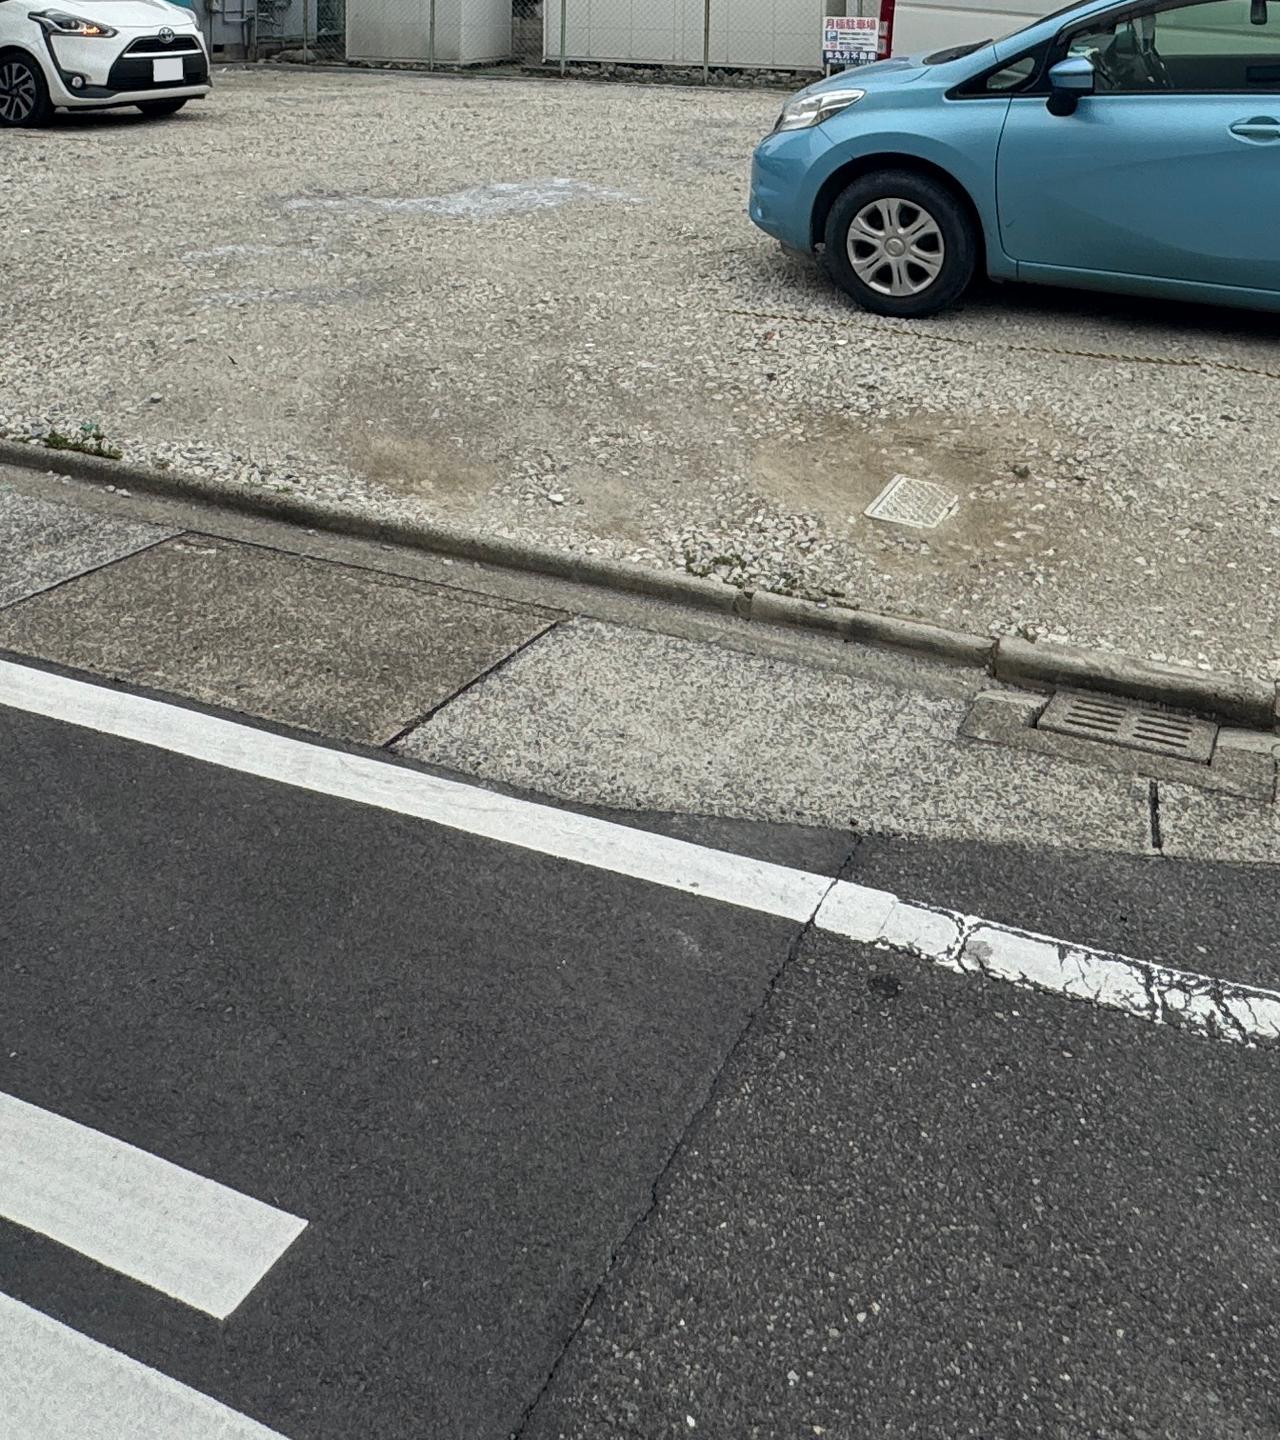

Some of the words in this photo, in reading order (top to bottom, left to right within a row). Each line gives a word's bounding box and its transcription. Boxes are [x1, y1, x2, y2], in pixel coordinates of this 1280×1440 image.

[825, 18, 876, 30] 月極駐車場
